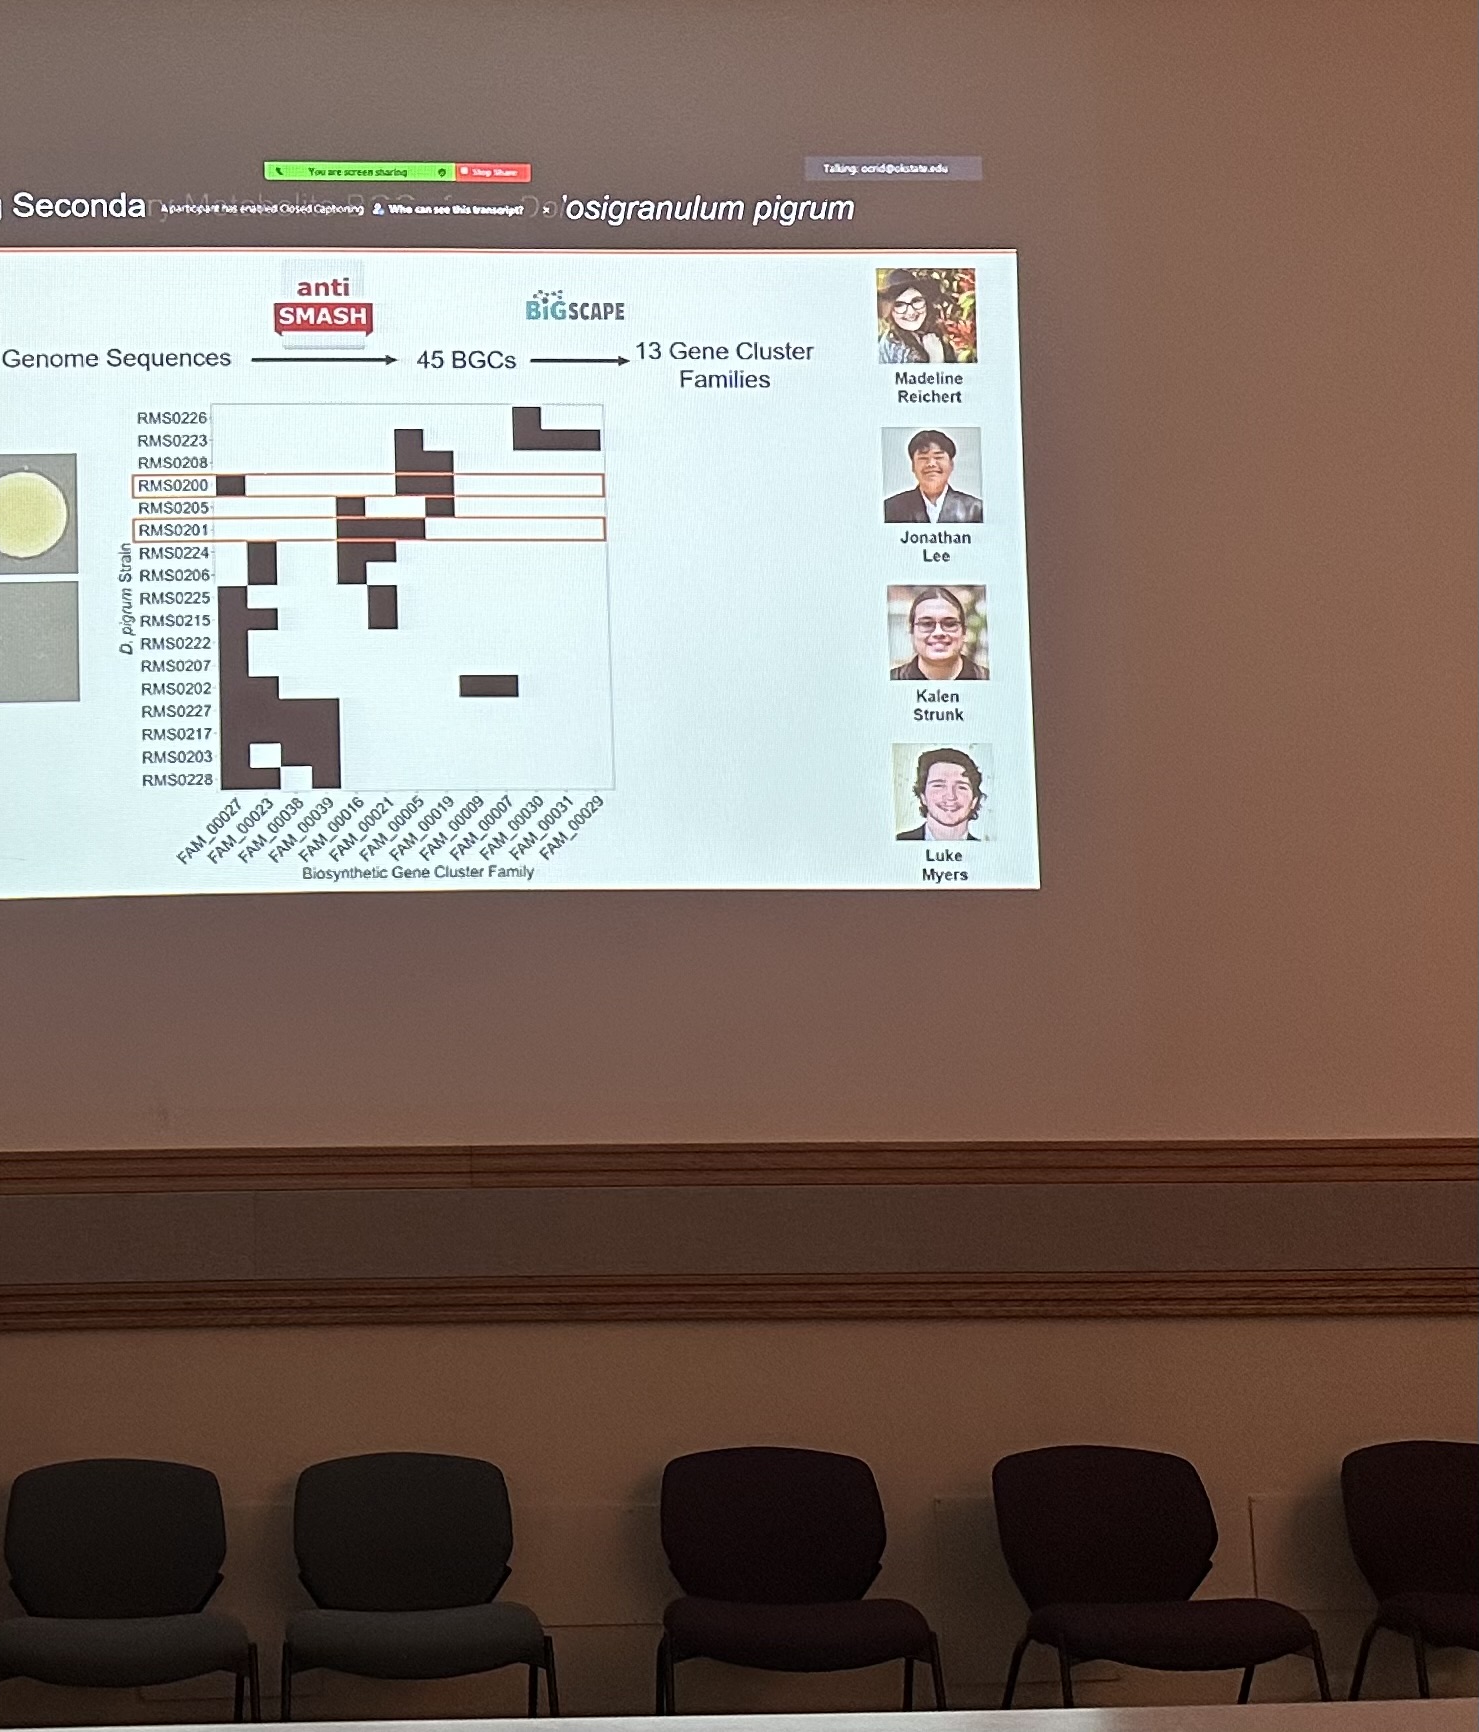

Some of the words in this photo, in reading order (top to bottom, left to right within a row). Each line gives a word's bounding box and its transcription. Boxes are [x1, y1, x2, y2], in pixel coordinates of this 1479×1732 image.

[308, 168, 326, 177] You
[327, 169, 342, 177] are
[344, 168, 373, 177] screen
[375, 167, 408, 178] sharing
[472, 168, 492, 178] Stop
[221, 203, 238, 213] has
[279, 203, 313, 213] Closed
[313, 203, 365, 216] Captioning
[388, 204, 413, 214] Who
[414, 205, 433, 214] can
[433, 205, 451, 214] see
[452, 204, 471, 214] this
[472, 204, 524, 217] transcript?
[752, 195, 855, 226] pigrum
[297, 277, 350, 298] anti
[278, 307, 368, 327] SMASH
[636, 342, 662, 361] 13
[669, 341, 728, 362] Gene
[734, 341, 815, 362] Cluster
[2, 349, 99, 370] Genome
[105, 348, 232, 374] Sequences
[416, 351, 445, 370] 45
[452, 350, 517, 371] BGCs
[680, 370, 771, 390] Families
[895, 371, 964, 386] Madeline
[898, 389, 963, 404] Reichert
[137, 411, 208, 425] RMS0226
[137, 434, 208, 447] RMS0223
[138, 456, 208, 469] RMS0208
[138, 479, 208, 492] RMS0200
[138, 501, 209, 514] RMS0205
[138, 524, 209, 537] RMS0201
[900, 530, 972, 545] Jonathan
[139, 546, 209, 560] RMS0224
[923, 549, 951, 562] Lee
[118, 542, 132, 583] Strain
[139, 569, 210, 582] RMS0206
[139, 592, 211, 605] RMS0225
[119, 588, 137, 636] pigrum
[139, 614, 211, 627] RMS0215
[140, 637, 211, 650] RMS0222
[141, 659, 211, 672] RMS0207
[141, 682, 212, 695] RMS0202
[916, 689, 960, 703] Kalen
[141, 704, 212, 718] RMS0227
[913, 708, 964, 722] Strunk
[141, 727, 212, 741] RMS0217
[142, 750, 213, 764] RMS0203
[142, 773, 214, 786] RMS0228
[176, 796, 242, 865] FAM_00027
[207, 797, 274, 864] FAM_00023
[237, 797, 304, 864] FAM_00038
[268, 797, 335, 863] FAM_00039
[298, 796, 365, 863] FAM_00016
[328, 796, 395, 862] FAM_00021
[358, 794, 424, 862] FAM_00005
[388, 795, 455, 862] FAM_00019
[418, 795, 485, 861] FAM_00009
[449, 794, 513, 861] FAM_00007
[479, 795, 544, 861] FAM_00030
[508, 795, 574, 861] FAM_00031
[538, 795, 604, 861] FAM_00029
[925, 849, 963, 862] Luke
[302, 866, 388, 882] Biosynthetic
[391, 865, 430, 879] Gene
[434, 864, 484, 879] Cluster
[488, 864, 535, 881] Family
[922, 867, 969, 884] Myers
